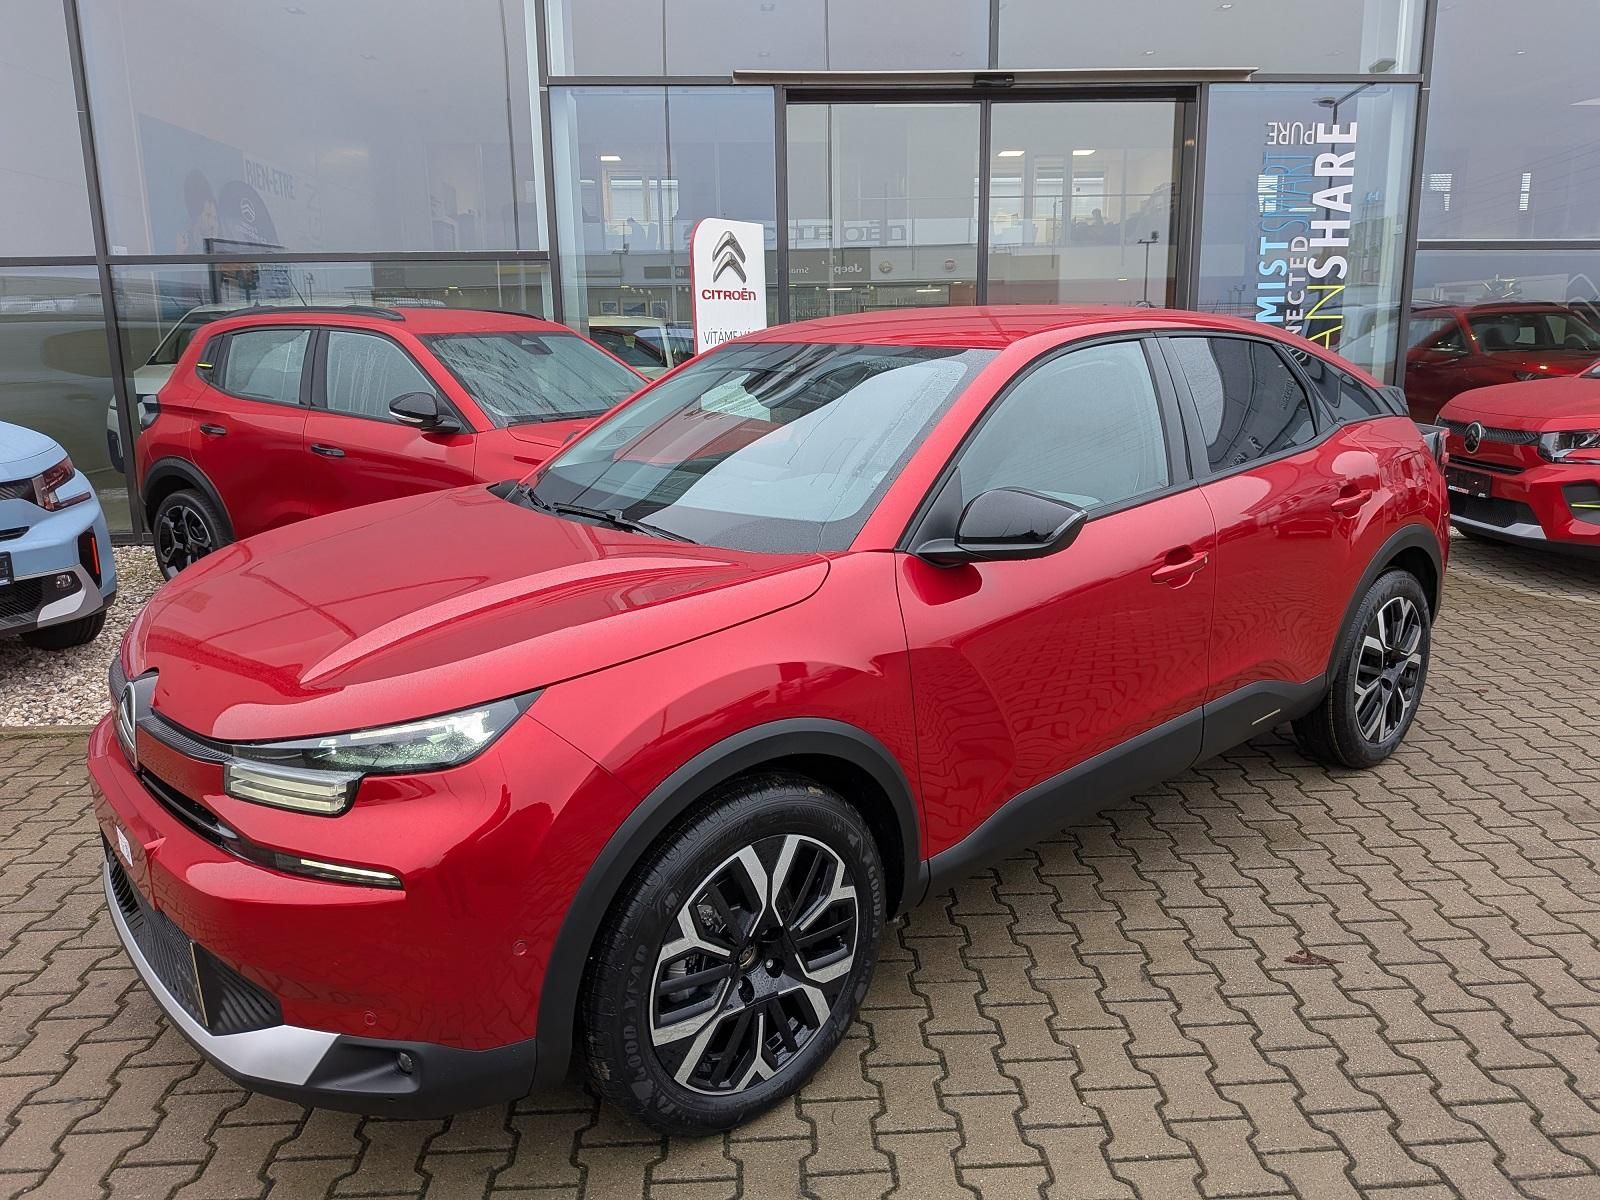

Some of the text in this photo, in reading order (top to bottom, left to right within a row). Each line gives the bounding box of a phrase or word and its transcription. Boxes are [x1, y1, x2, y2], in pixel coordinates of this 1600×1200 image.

[1266, 121, 1316, 145] PURE
[1262, 151, 1314, 235] SMART
[1308, 121, 1358, 280] SHARE
